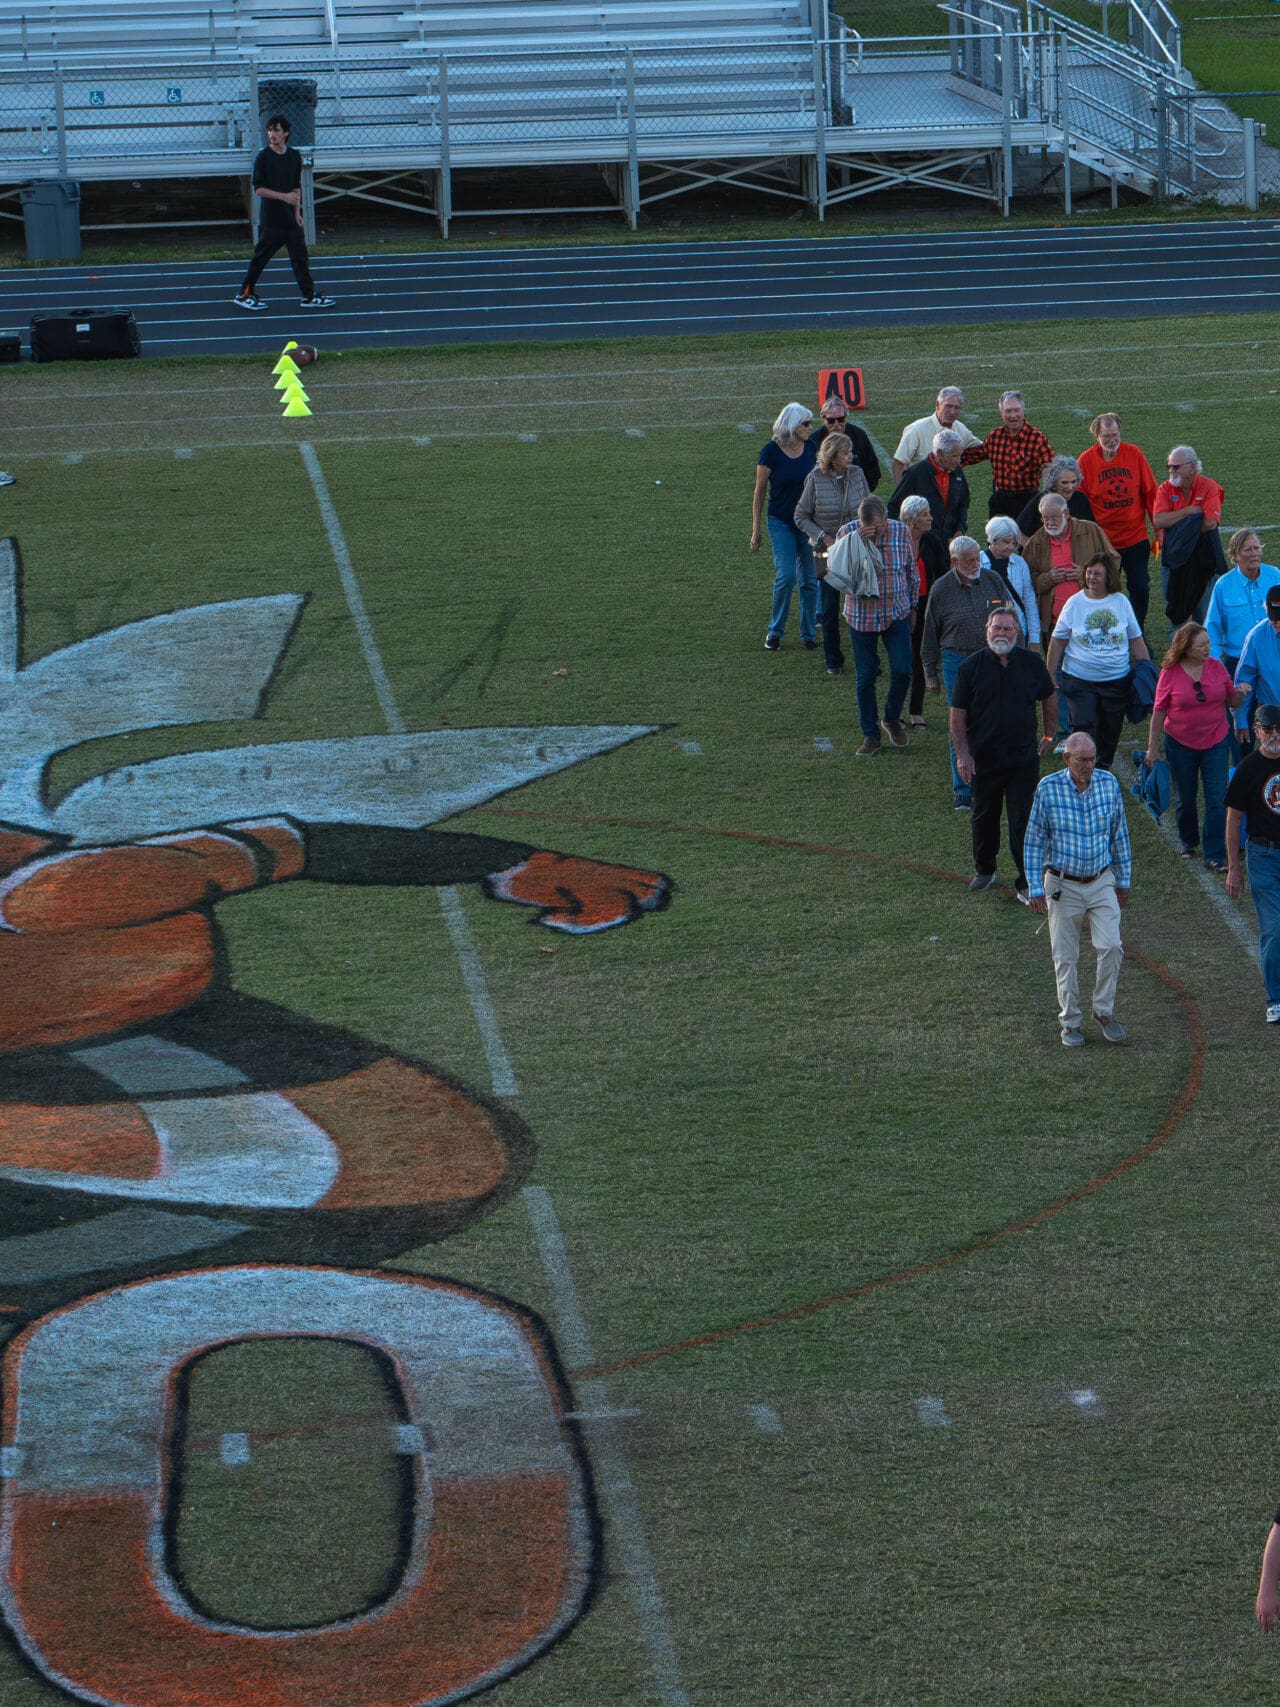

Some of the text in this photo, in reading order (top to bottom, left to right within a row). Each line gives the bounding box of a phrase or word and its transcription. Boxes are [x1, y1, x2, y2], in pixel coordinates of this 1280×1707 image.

[825, 370, 861, 407] 40
[1097, 466, 1133, 483] LEESBURG
[1102, 497, 1135, 509] SOCCER
